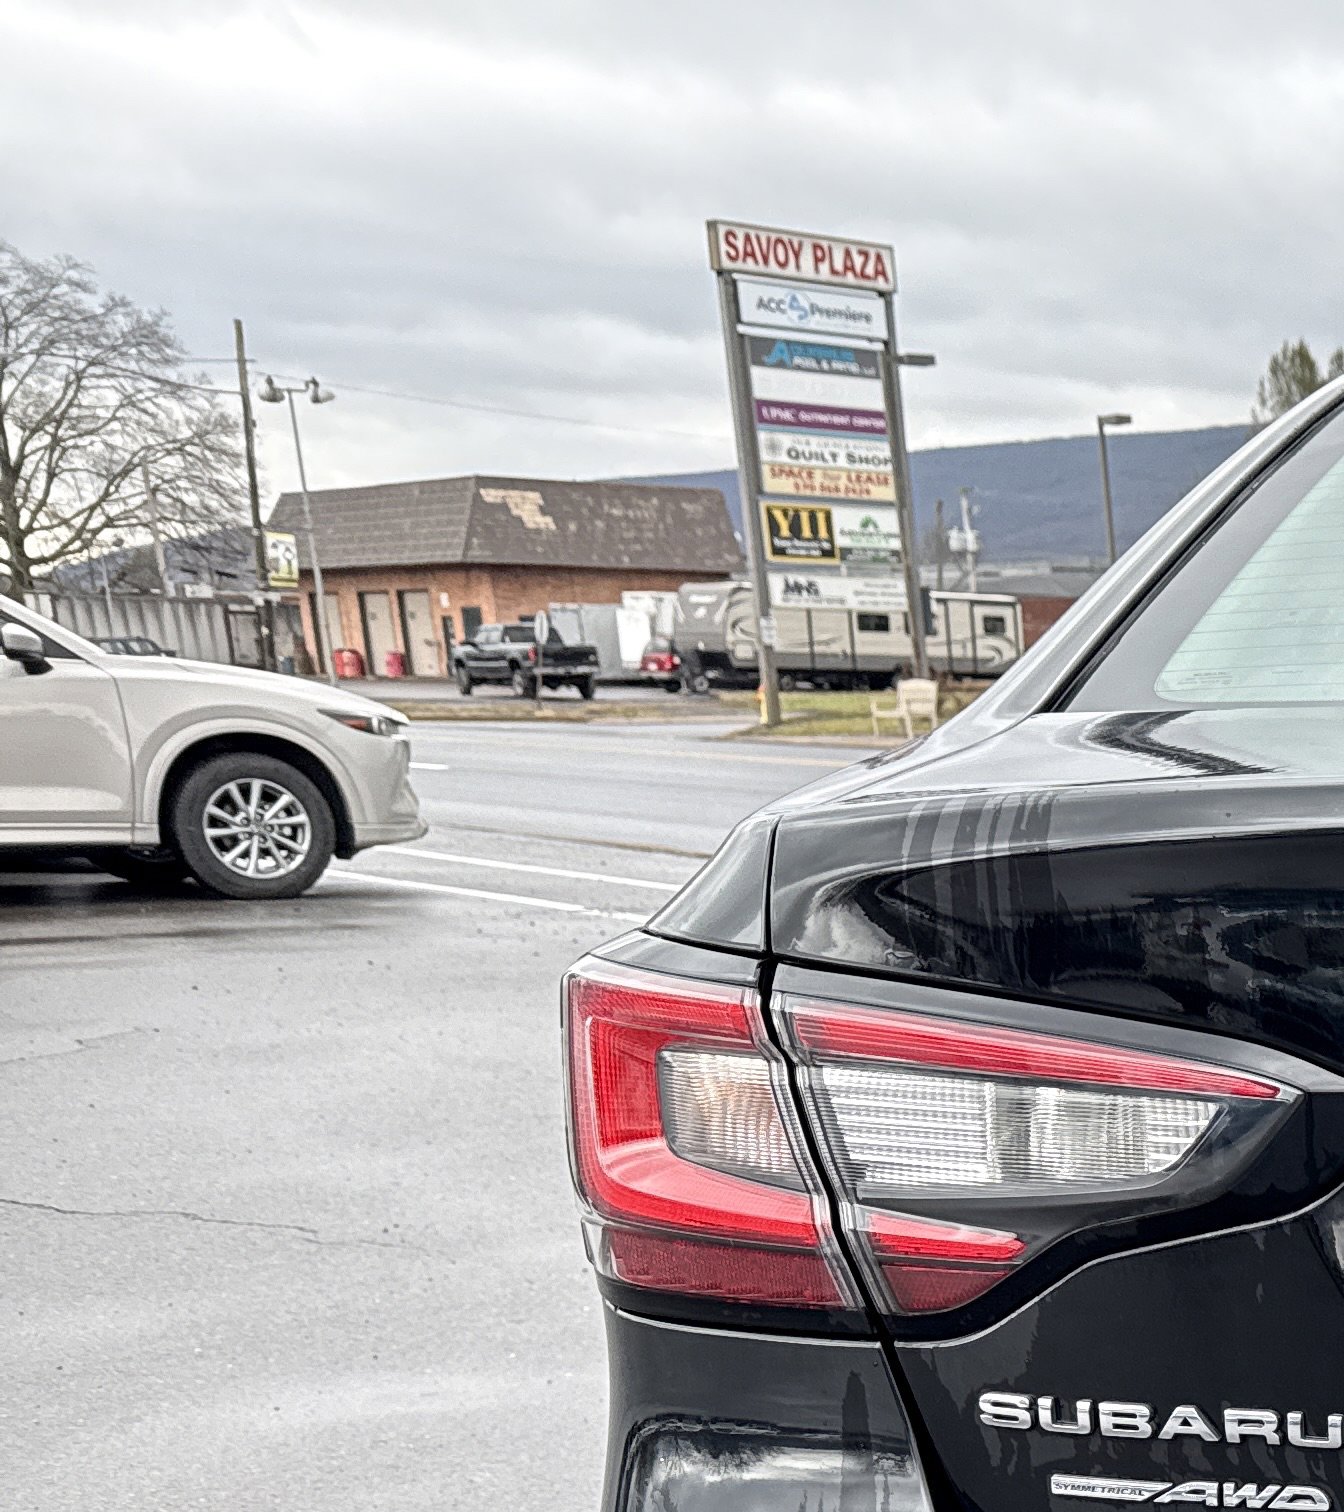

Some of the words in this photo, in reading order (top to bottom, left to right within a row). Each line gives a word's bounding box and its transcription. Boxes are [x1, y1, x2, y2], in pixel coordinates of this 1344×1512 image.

[724, 229, 804, 272] SAVOY
[811, 241, 890, 284] PLAZA
[786, 446, 839, 465] QUILT
[769, 465, 815, 481] SPACE
[846, 472, 890, 486] LEASE
[1053, 1481, 1146, 1497] SYMMETRICAL
[1153, 1480, 1333, 1512] AWD
